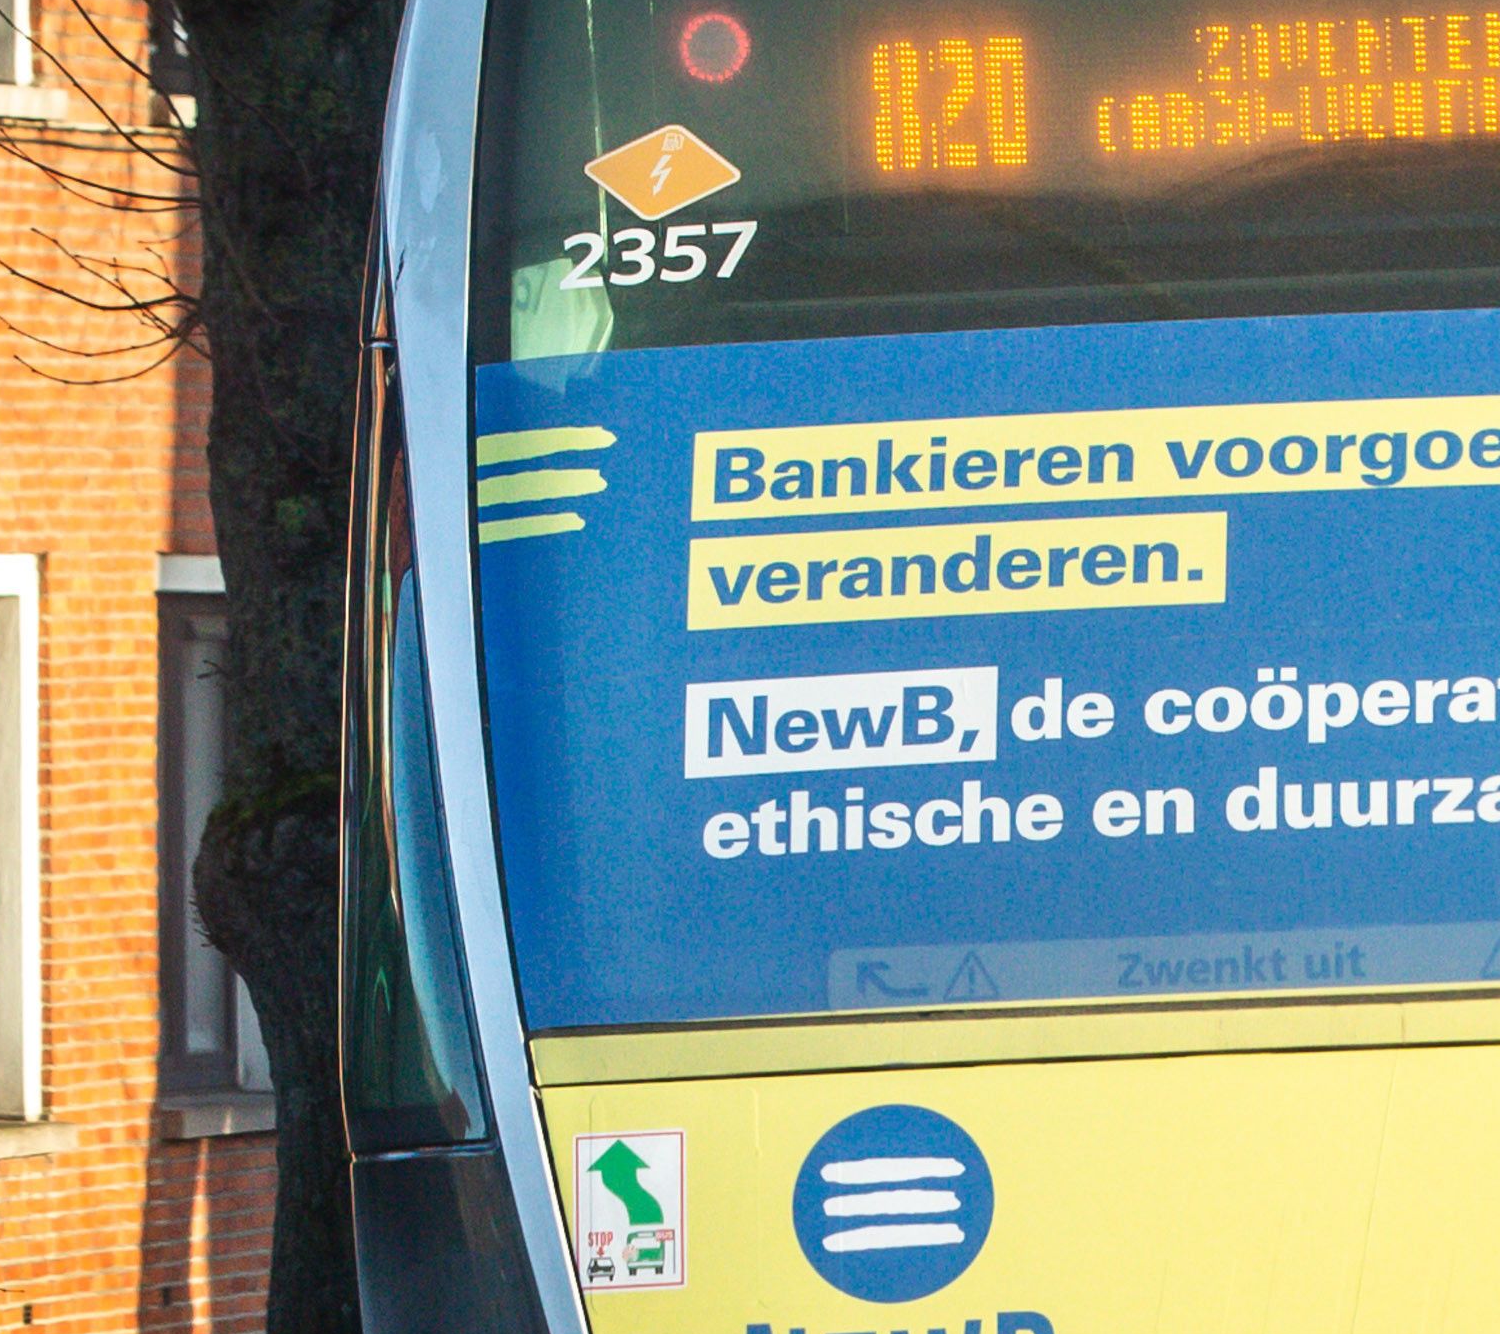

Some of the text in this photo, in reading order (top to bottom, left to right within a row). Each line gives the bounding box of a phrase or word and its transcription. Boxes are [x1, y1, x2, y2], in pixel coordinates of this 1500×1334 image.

[872, 36, 1028, 172] 820
[559, 221, 759, 290] 2357
[712, 434, 1135, 504] Bankieren
[708, 534, 1203, 607] veranderen.
[706, 684, 981, 759] NewB,
[1011, 677, 1116, 742] de
[703, 779, 1064, 860] ethische
[1092, 785, 1195, 837] en
[1118, 940, 1366, 988] Zwenkt uit
[588, 1231, 613, 1247] STOP
